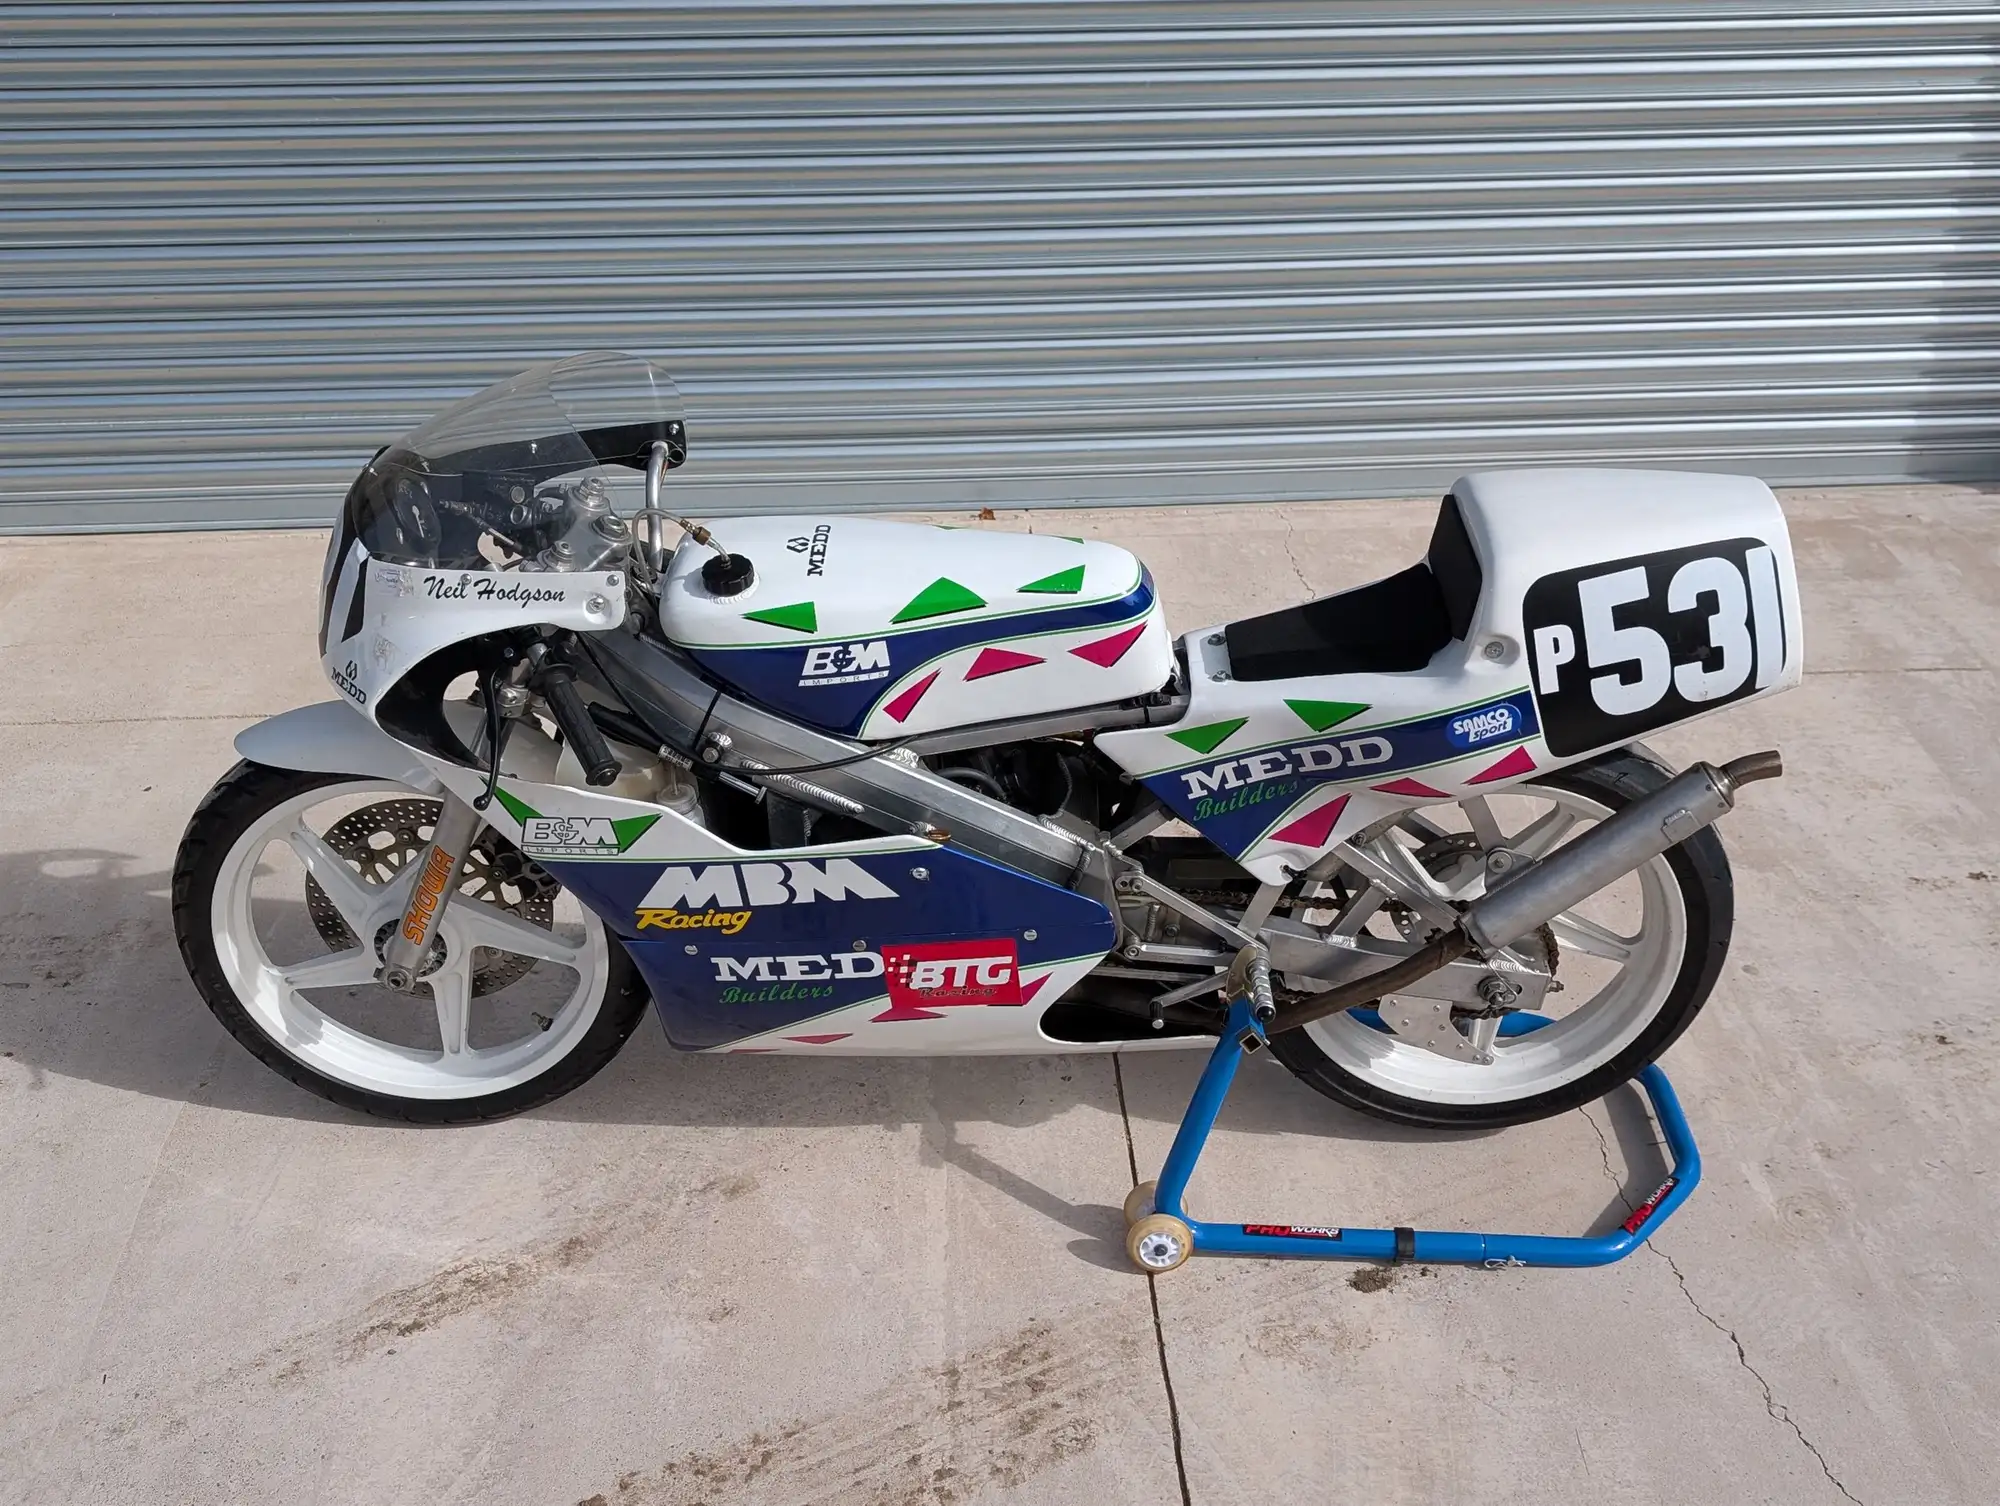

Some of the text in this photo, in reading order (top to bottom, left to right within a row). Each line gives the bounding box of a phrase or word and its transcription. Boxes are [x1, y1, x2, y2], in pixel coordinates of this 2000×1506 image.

[807, 524, 831, 576] MEDD
[424, 575, 468, 600] Neil
[473, 578, 567, 608] Hodgson
[802, 640, 891, 676] B&M
[331, 667, 367, 705] MEDD
[803, 672, 887, 686] IMPORTS
[1453, 708, 1509, 735] SAMCO
[1181, 736, 1393, 799] MEDD
[1193, 778, 1299, 822] Builders
[522, 817, 620, 846] B&M
[524, 847, 616, 855] IMPORTS
[403, 845, 456, 946] SHOWA
[637, 858, 900, 909] MBM
[635, 908, 752, 935] Racing
[909, 956, 1013, 990] BTG
[719, 982, 834, 1004] Builders
[918, 985, 997, 998] Racing
